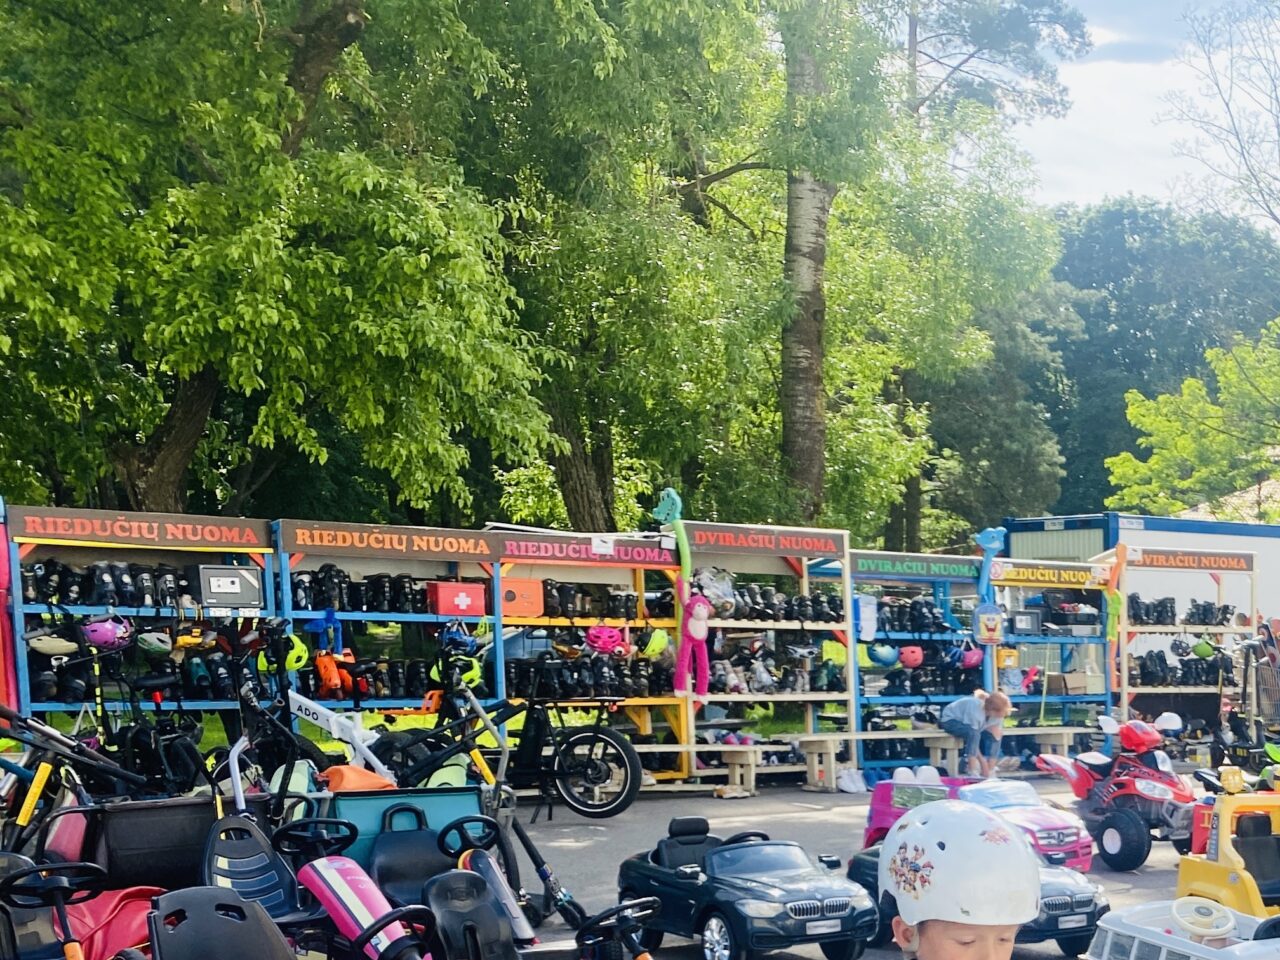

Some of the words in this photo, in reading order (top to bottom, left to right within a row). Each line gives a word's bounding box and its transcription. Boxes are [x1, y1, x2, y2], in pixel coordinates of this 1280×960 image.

[24, 516, 158, 541] RIEDUČIŲ
[165, 523, 259, 544] NUOMA
[295, 528, 408, 552] RIEDUČIŲ
[412, 535, 491, 555] NUOMA
[694, 530, 776, 549] DVIRAČIŲ
[779, 536, 837, 552] NUOMA
[857, 558, 927, 575] DVIRAČIŲ
[930, 563, 979, 577] NUOMA
[1201, 556, 1248, 569] NUOMA
[1004, 566, 1058, 583] EDUČIŲ
[1060, 570, 1092, 583] NUO
[297, 705, 319, 720] ADO
